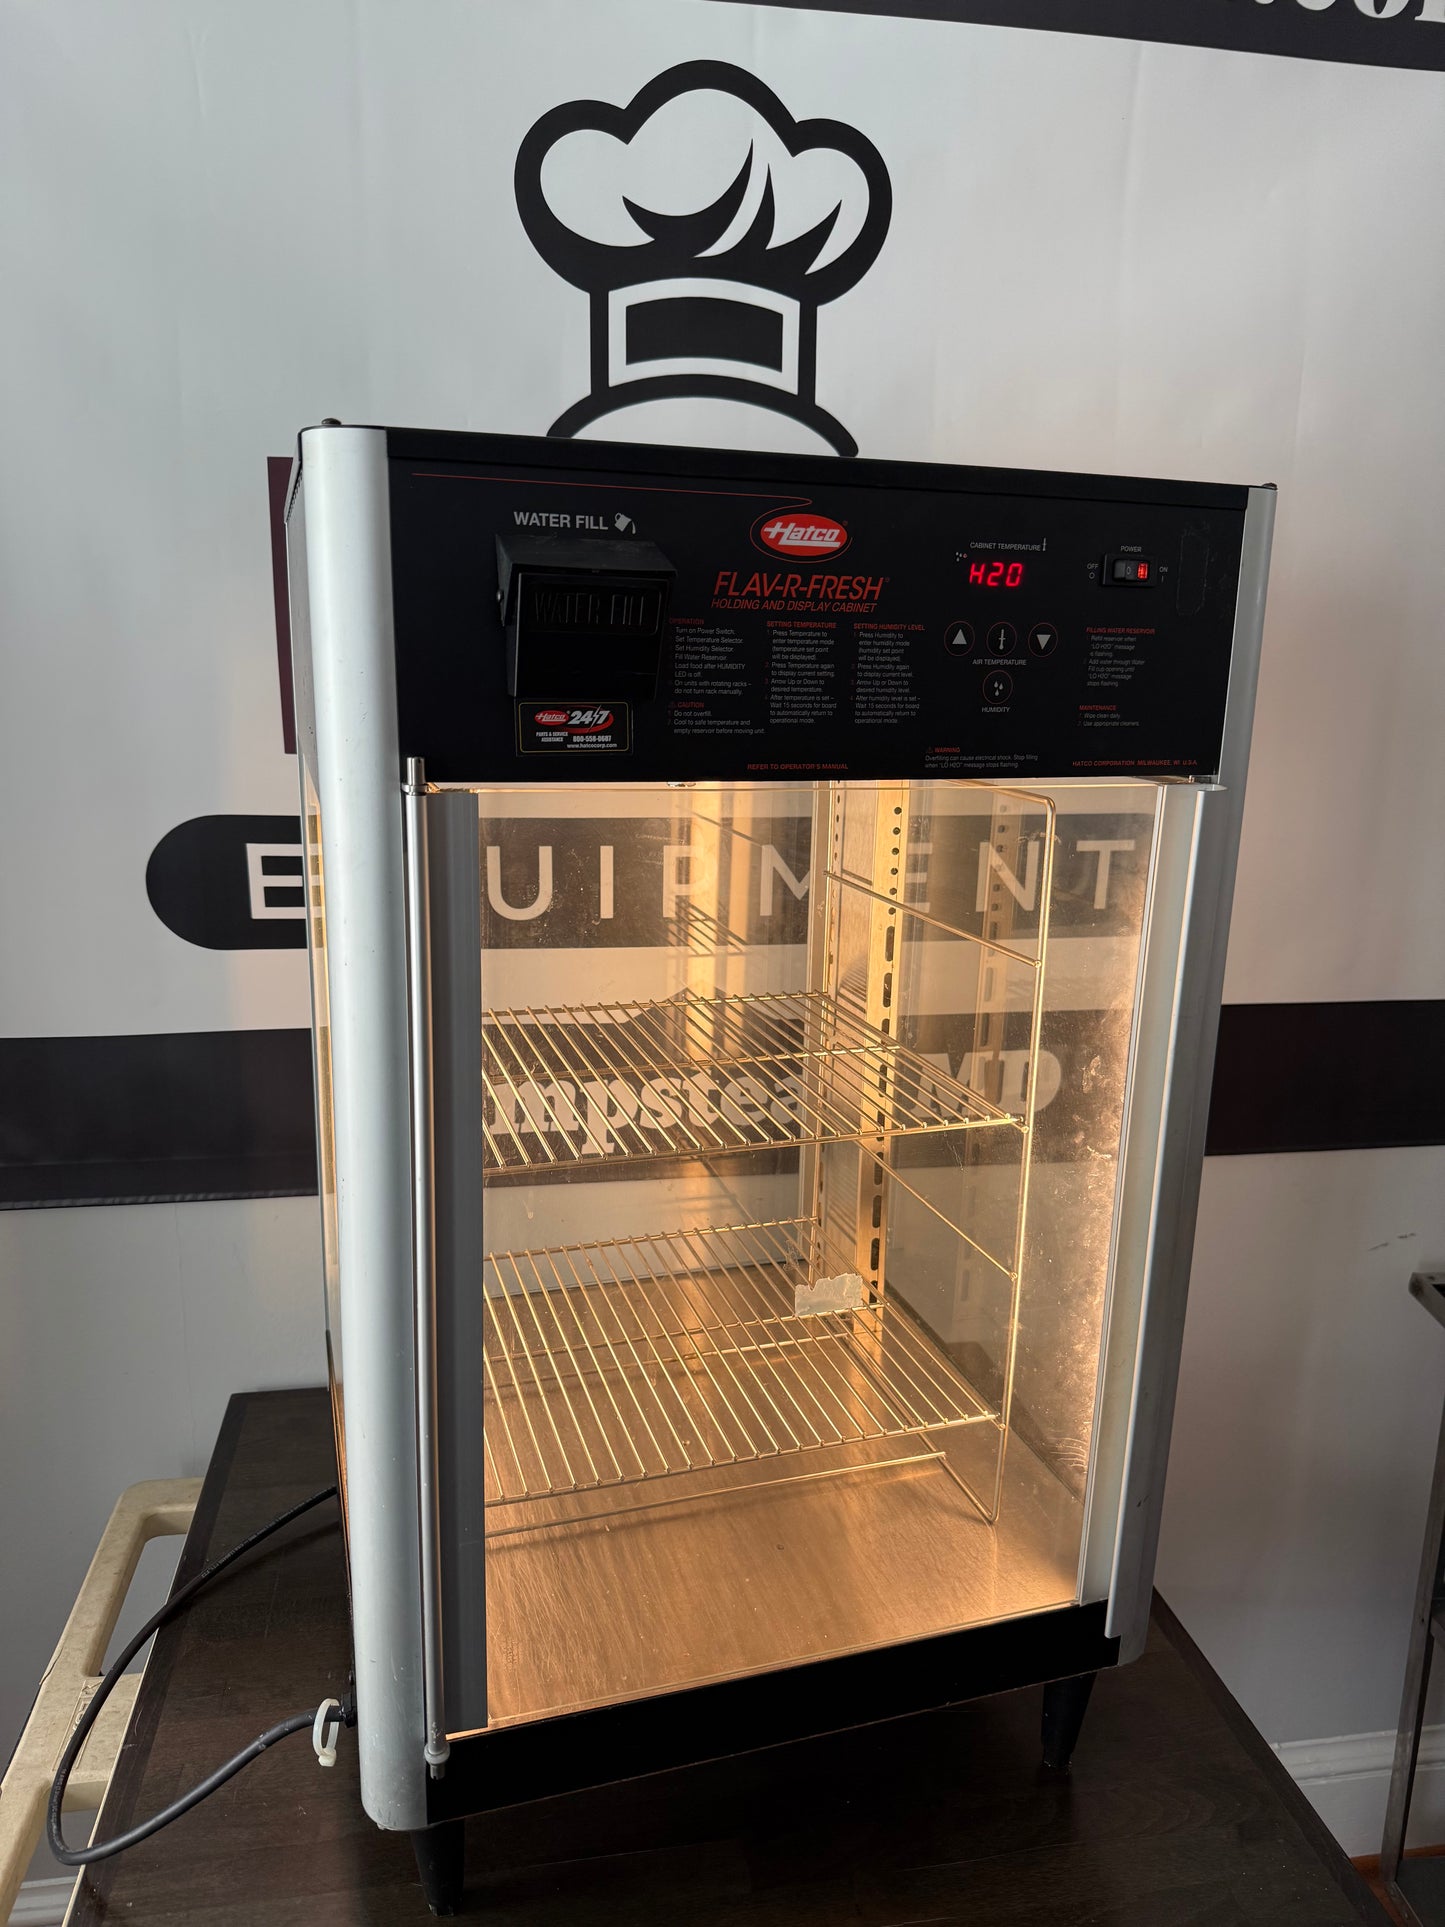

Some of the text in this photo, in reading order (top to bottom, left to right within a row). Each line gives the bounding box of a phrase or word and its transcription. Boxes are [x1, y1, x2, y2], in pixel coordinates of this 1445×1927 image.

[513, 511, 609, 530] WATER FILL
[764, 522, 841, 547] Hatco
[970, 542, 1041, 551] CABINET TEMPERATURE
[713, 571, 885, 601] FLAV-R-FRESH
[711, 598, 878, 613] HOLDING AND DISPLAY CABINET
[535, 713, 567, 722] Hatco
[246, 840, 1136, 921] EUIPMENT
[482, 1066, 803, 1155] mpstea
